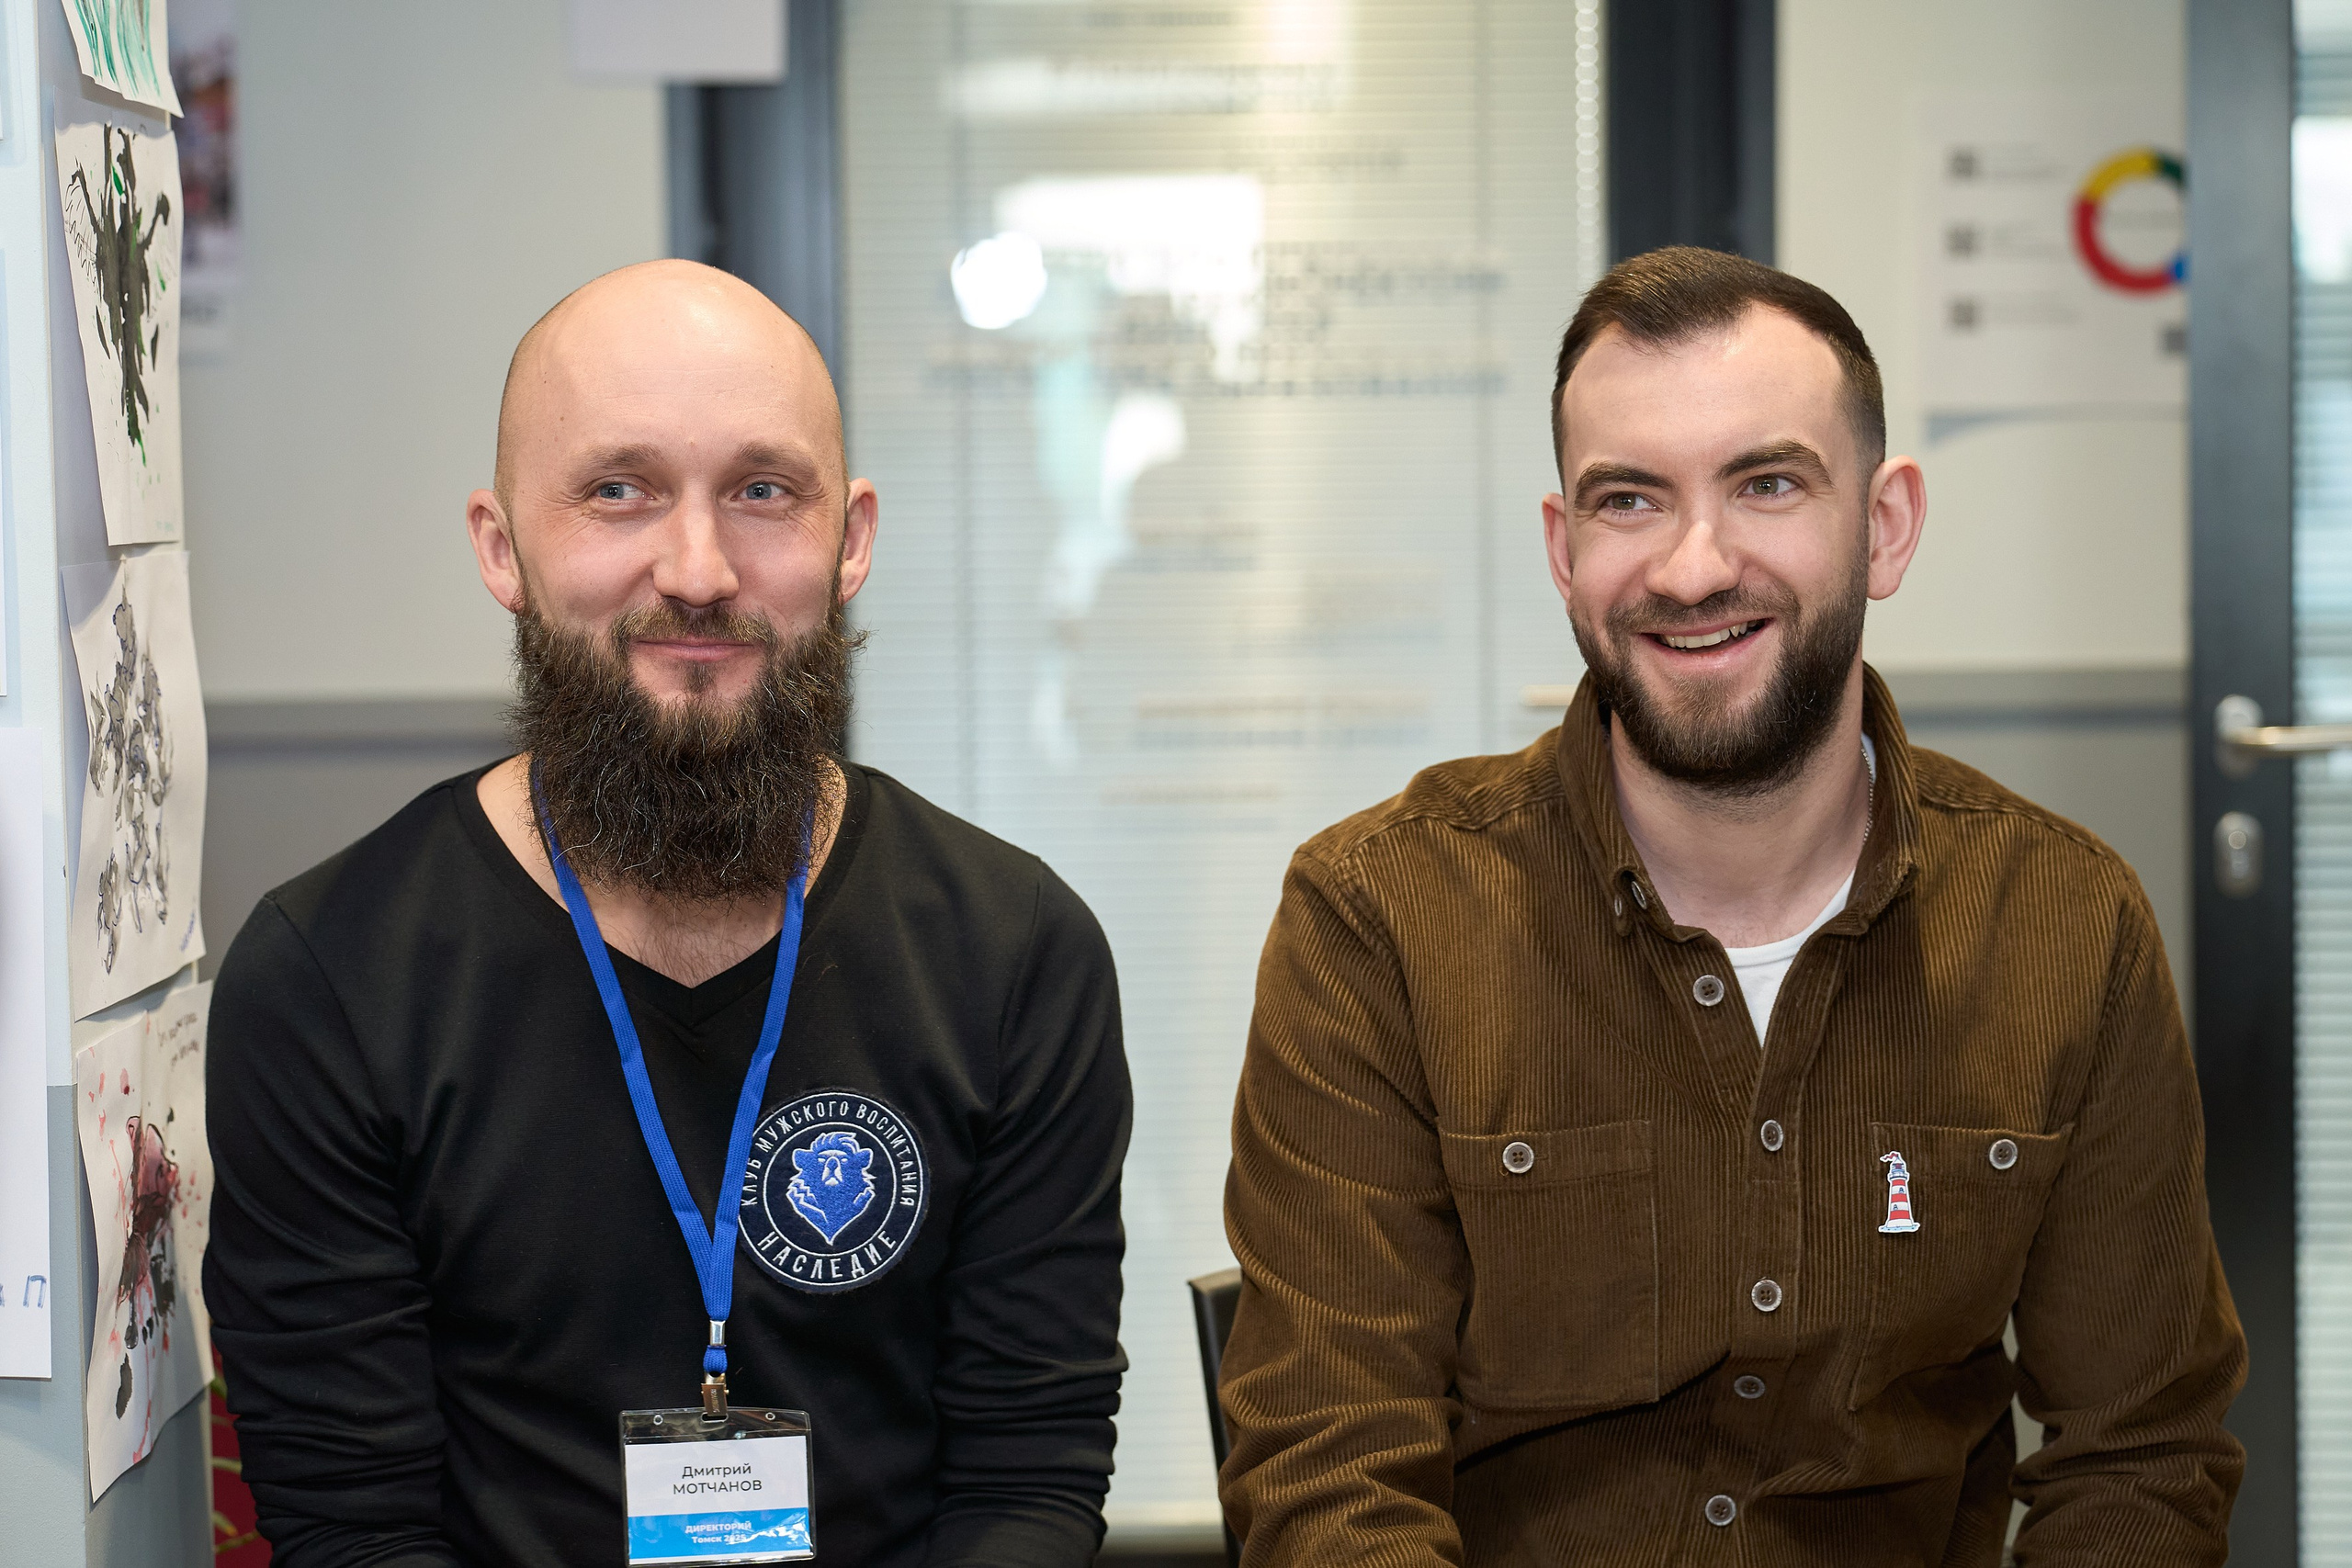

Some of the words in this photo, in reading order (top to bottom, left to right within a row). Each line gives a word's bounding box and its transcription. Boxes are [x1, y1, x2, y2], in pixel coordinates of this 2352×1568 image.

[741, 1158, 762, 1206] КЛУБ
[755, 1100, 849, 1153] МУЖСКОГО
[855, 1104, 918, 1207] ВОСПИТАНИЯ
[757, 1230, 897, 1280] НАСЛЕДИЕ
[682, 1462, 752, 1479] Дмитрий
[673, 1480, 763, 1495] МОТЧАНОВ
[684, 1520, 752, 1534] ДИРЕКТОРИЙ
[691, 1536, 722, 1544] Томск
